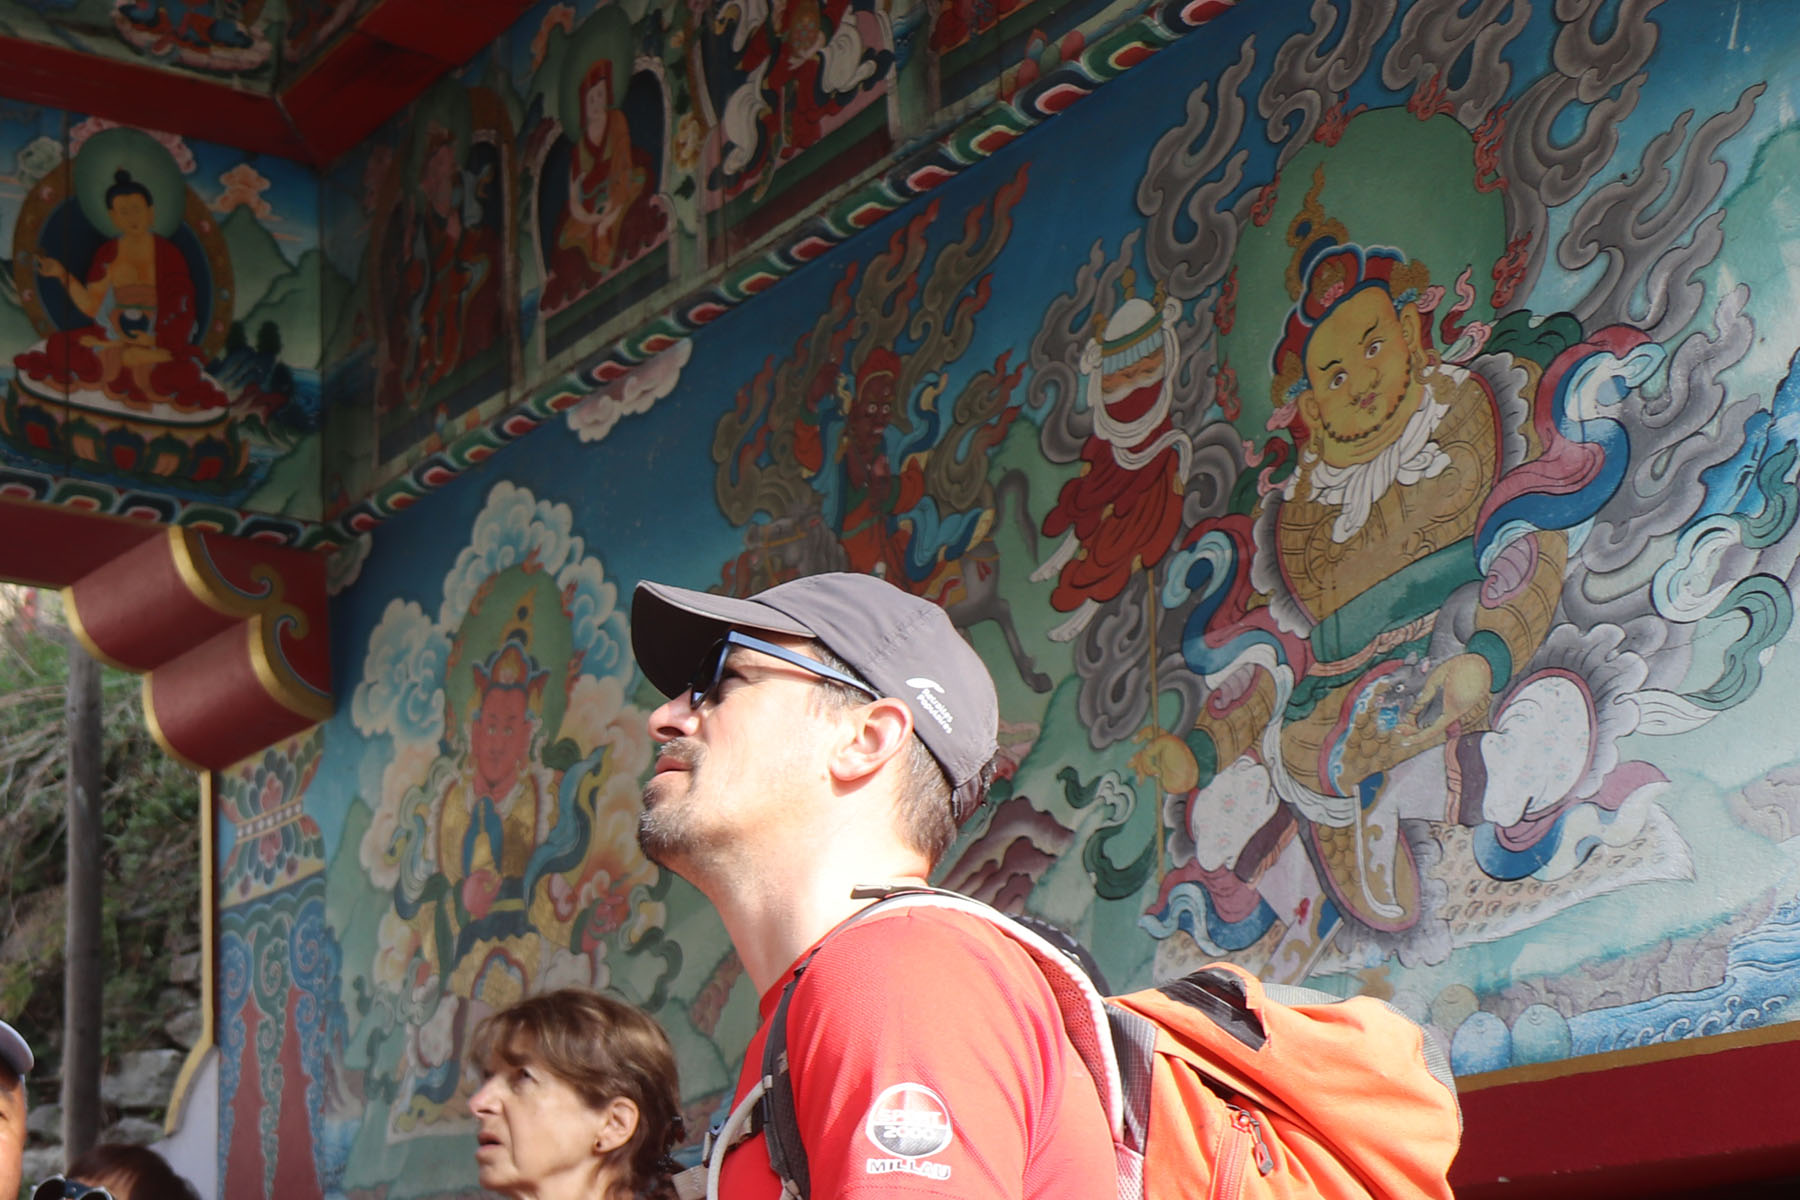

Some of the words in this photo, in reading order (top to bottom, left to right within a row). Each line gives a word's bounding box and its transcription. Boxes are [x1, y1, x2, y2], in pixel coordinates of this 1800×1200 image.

[878, 1108, 942, 1125] SPT
[883, 1124, 937, 1141] 2000
[868, 1159, 950, 1180] MILLAU
